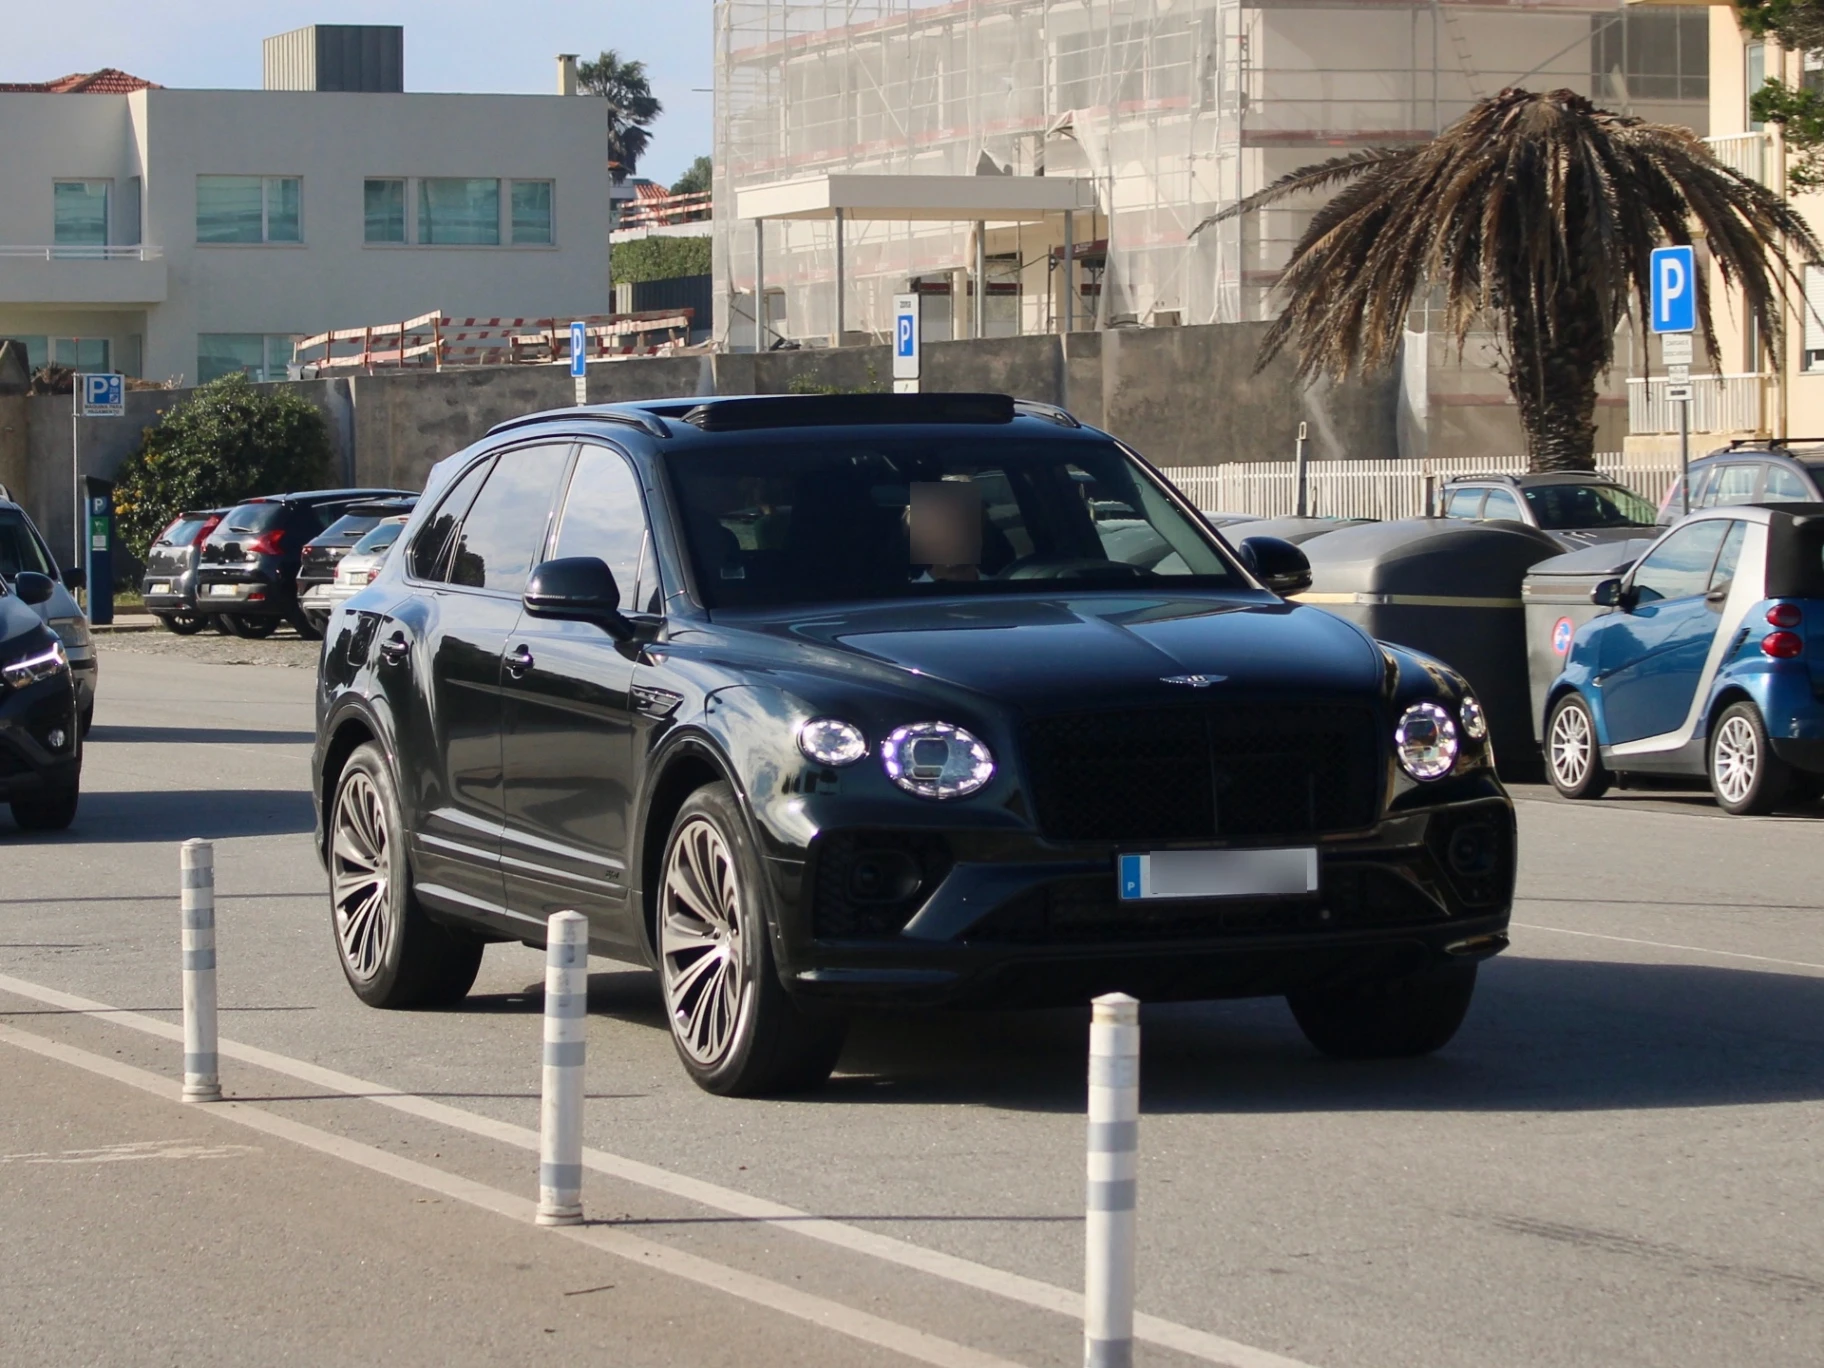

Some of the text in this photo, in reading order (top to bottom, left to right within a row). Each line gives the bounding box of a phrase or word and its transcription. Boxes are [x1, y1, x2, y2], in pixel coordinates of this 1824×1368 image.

[1660, 258, 1684, 322] P
[573, 328, 582, 371] P
[901, 319, 910, 352] P
[89, 377, 108, 402] P
[94, 498, 103, 511] P
[1127, 882, 1135, 891] P
